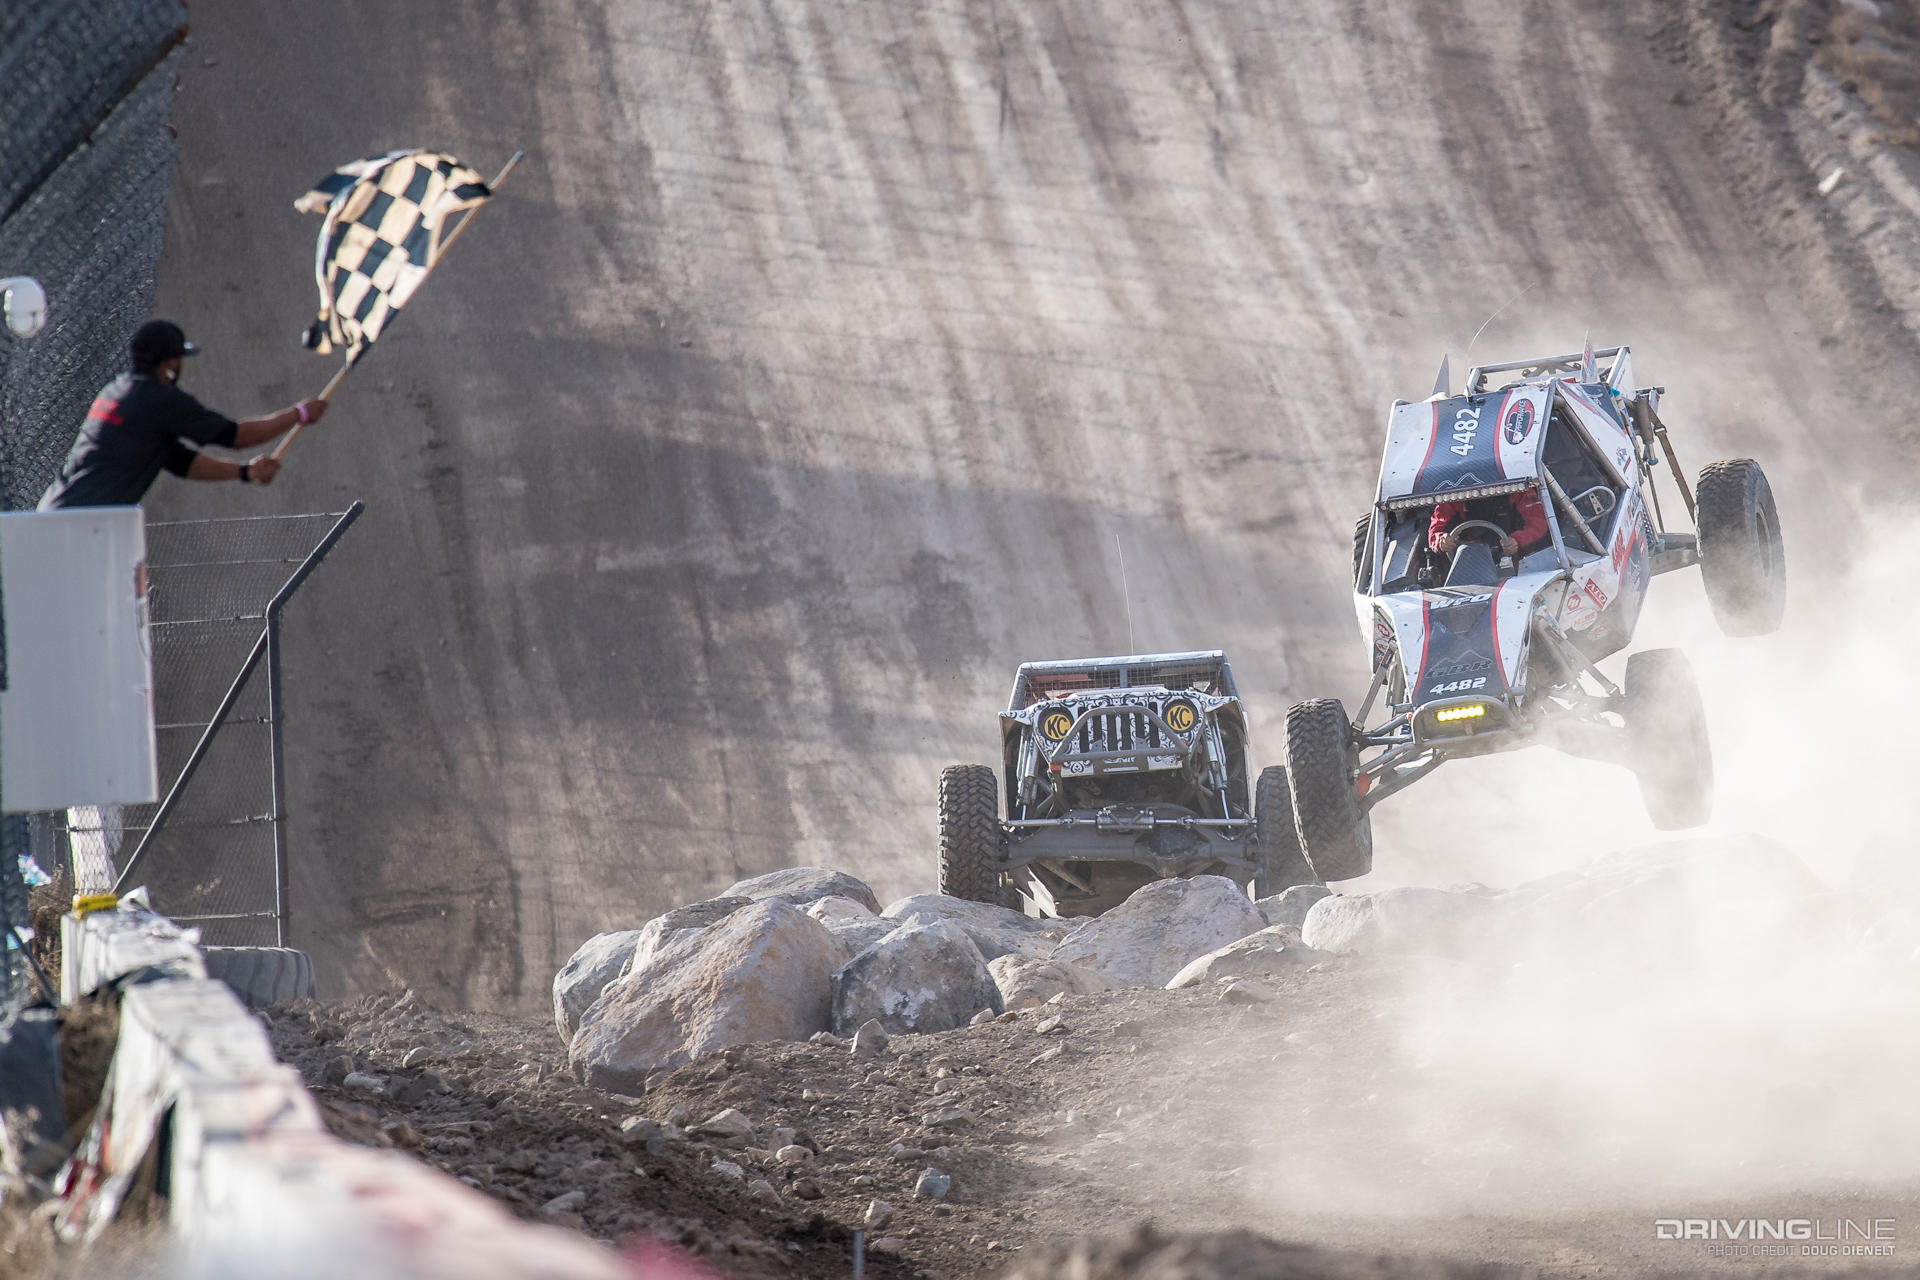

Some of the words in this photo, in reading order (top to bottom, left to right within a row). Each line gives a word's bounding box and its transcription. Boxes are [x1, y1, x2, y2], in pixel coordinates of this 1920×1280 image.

[1450, 407, 1481, 456] 4482
[1430, 592, 1493, 609] WFO
[1586, 582, 1607, 603] ATO
[1425, 660, 1493, 678] GBR
[1429, 676, 1487, 694] 4482
[1047, 714, 1068, 739] KC
[1170, 706, 1190, 730] KC
